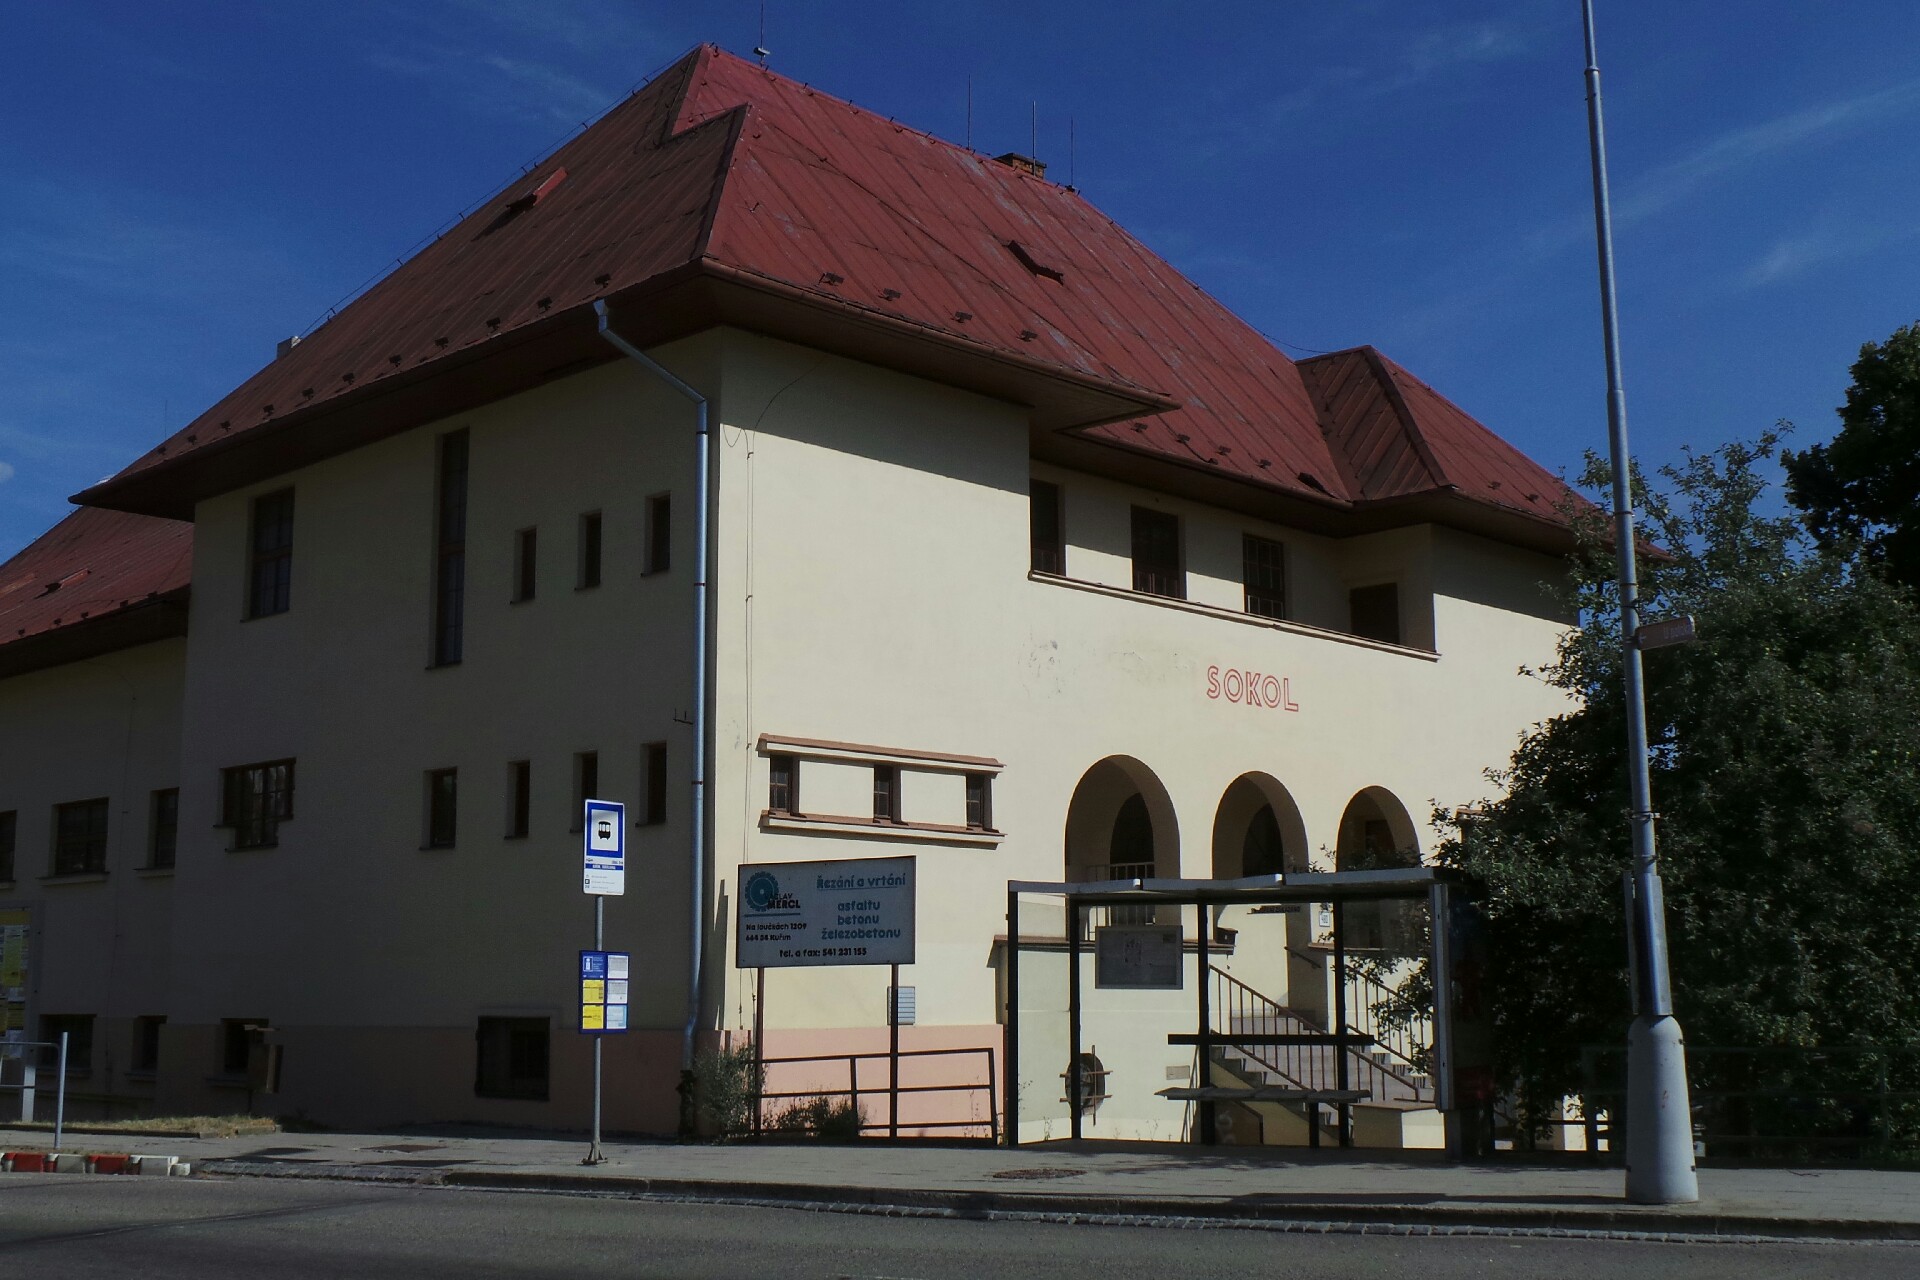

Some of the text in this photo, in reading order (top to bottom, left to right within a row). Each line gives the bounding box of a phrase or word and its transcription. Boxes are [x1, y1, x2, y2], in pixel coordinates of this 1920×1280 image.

[1206, 665, 1299, 712] SOKOL
[817, 873, 906, 889] Řezání a vrtání
[767, 900, 801, 909] MERCL
[838, 900, 881, 911] asfaltu
[838, 914, 879, 925] betonu
[803, 949, 821, 957] fax:
[822, 948, 836, 956] 541
[838, 948, 852, 956] 231
[854, 947, 867, 956] 155
